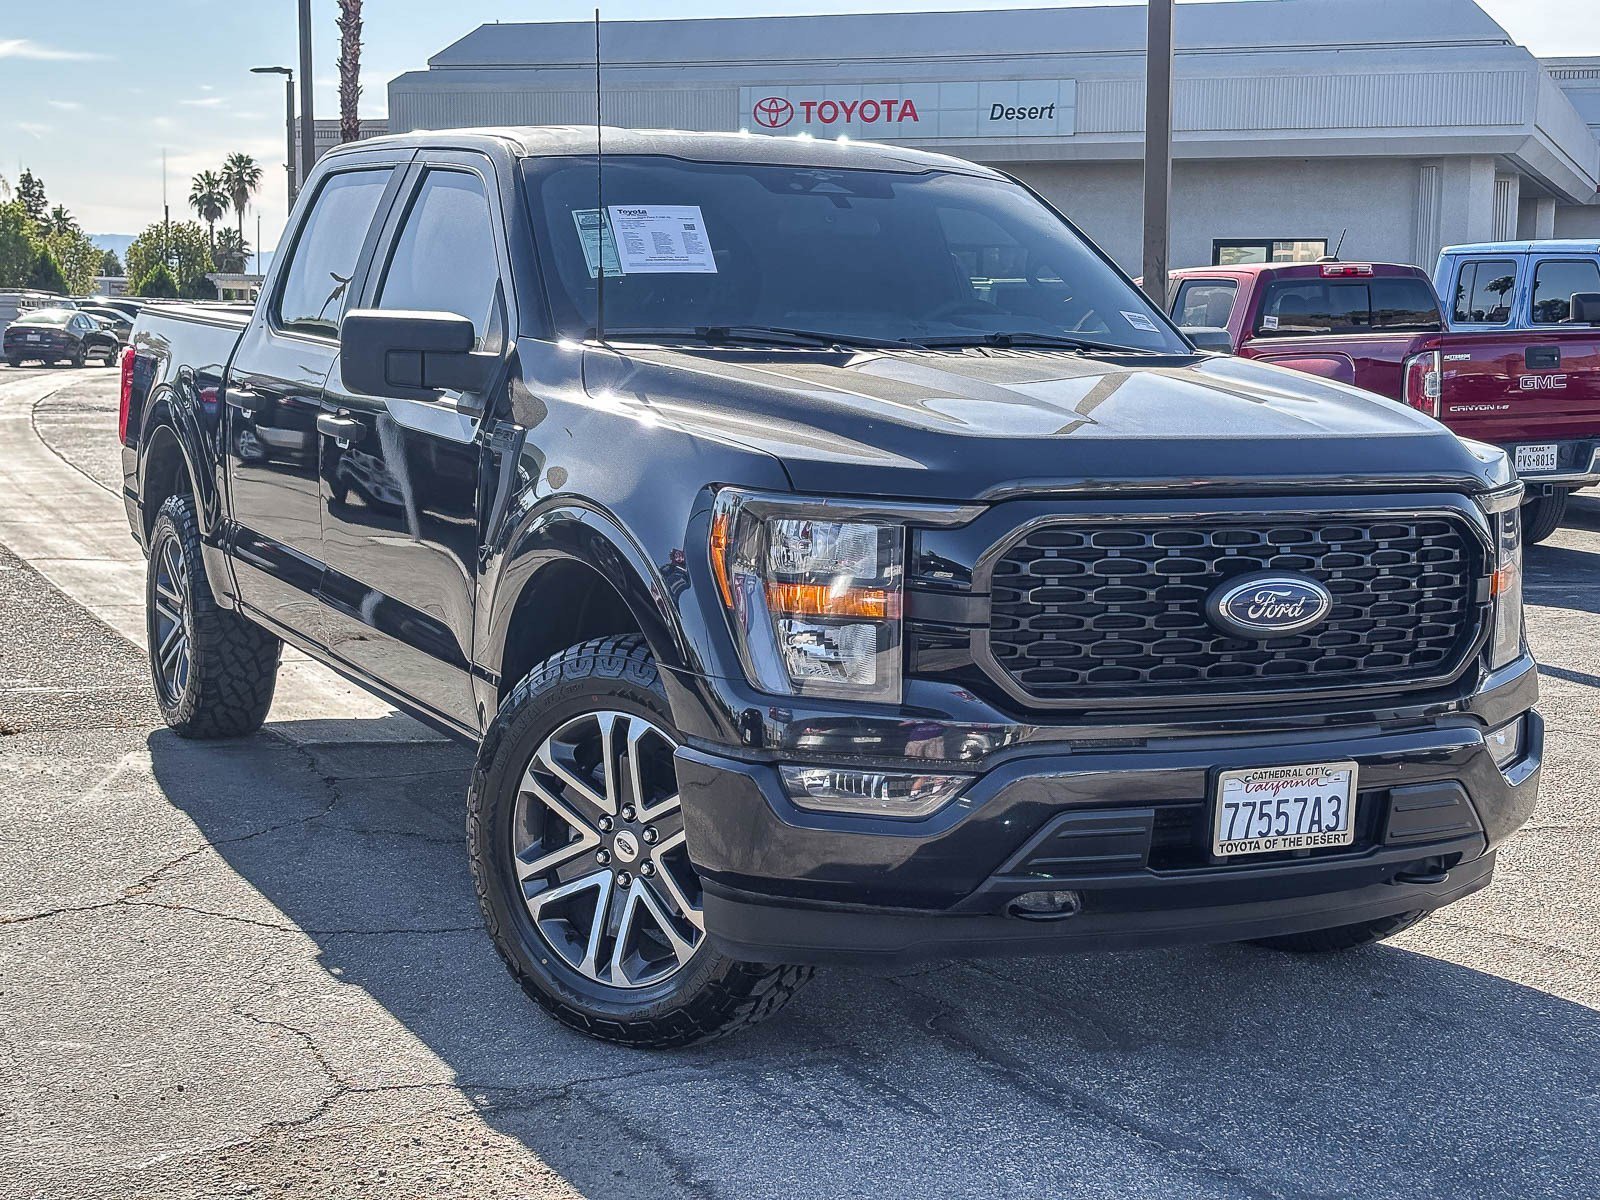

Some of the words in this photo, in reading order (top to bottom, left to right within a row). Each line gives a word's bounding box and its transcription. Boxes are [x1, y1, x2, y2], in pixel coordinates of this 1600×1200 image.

[799, 99, 919, 124] TOYOTA
[989, 102, 1055, 122] Desert
[617, 208, 647, 217] Toyota
[1519, 374, 1568, 390] GMC
[1450, 404, 1495, 412] CANYON
[1247, 590, 1306, 619] Ford
[1251, 768, 1303, 781] CATHEDRAL
[1306, 766, 1326, 777] CITY
[1224, 795, 1342, 841] 77557A3
[1219, 840, 1261, 854] TOYOTA
[1264, 838, 1278, 849] OF
[1281, 836, 1303, 848] THE
[1305, 832, 1348, 846] DESERT
